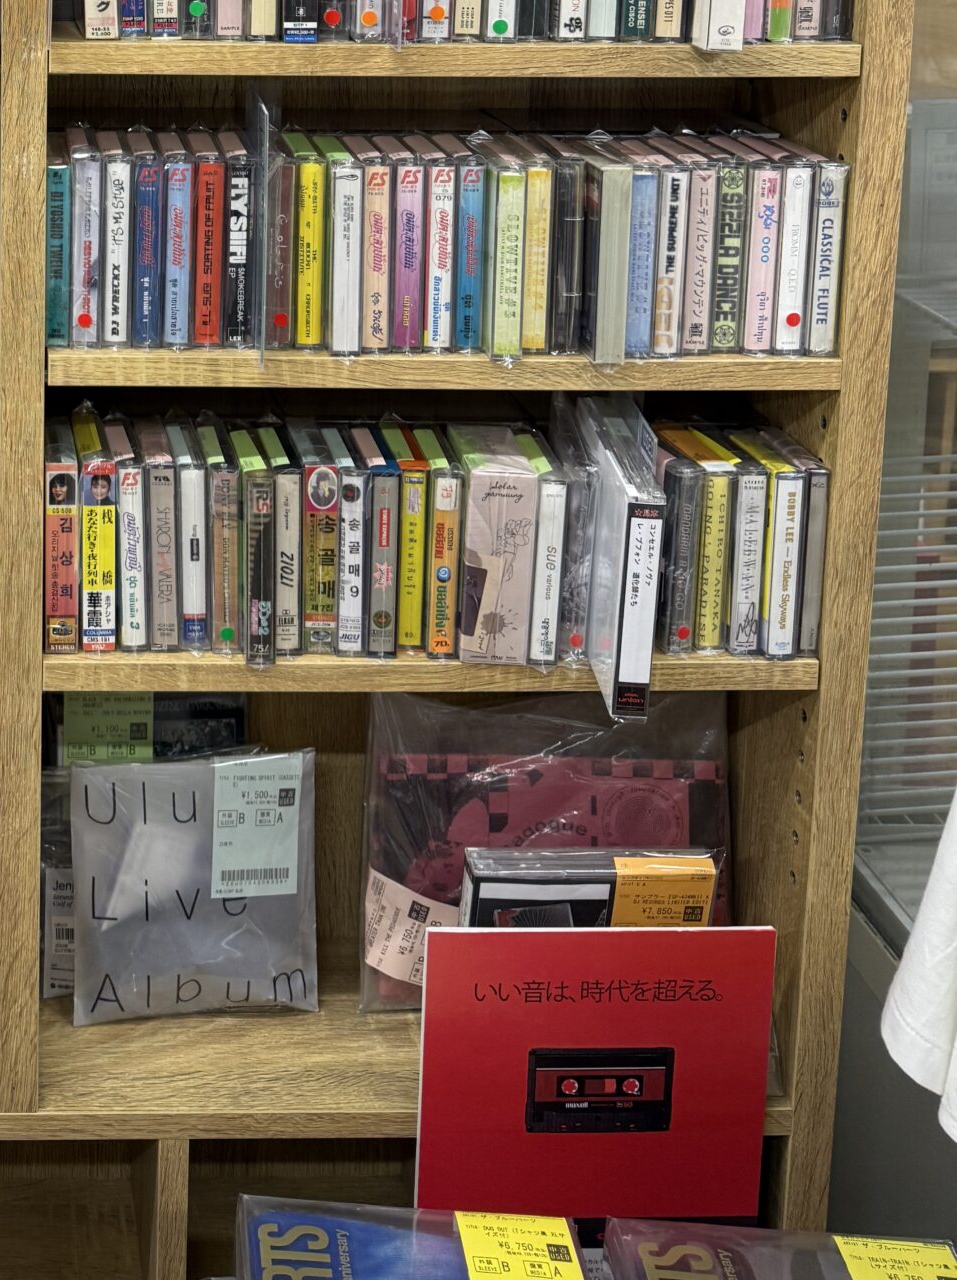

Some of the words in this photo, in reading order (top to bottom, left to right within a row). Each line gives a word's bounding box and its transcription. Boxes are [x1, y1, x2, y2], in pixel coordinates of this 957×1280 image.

[628, 6, 636, 27] CISCO
[664, 11, 674, 23] 011
[670, 177, 680, 202] UNIT
[50, 204, 63, 239] YOSHIO
[666, 205, 679, 252] SUPREME
[665, 254, 675, 274] THE
[818, 218, 834, 280] CLASSICAL
[229, 267, 236, 278] EP
[111, 263, 121, 316] WRECKX
[236, 267, 244, 322] SMOKEBREAK
[816, 288, 830, 325] FLUTE
[111, 320, 120, 336] DJ
[785, 491, 797, 523] BOBBY
[716, 493, 726, 559] ICHIRO
[785, 527, 795, 543] LEE
[59, 517, 74, 599] 김상희
[348, 518, 361, 577] 송골매
[545, 545, 557, 571] sue
[349, 585, 359, 598] 9
[545, 574, 553, 600] various
[781, 560, 792, 592] Endless
[711, 563, 722, 633] TANAKA
[778, 594, 790, 630] Skyways
[90, 968, 307, 1013] Album
[473, 979, 723, 1004] いい音は、時代を超える。
[502, 1262, 510, 1273] B
[553, 1266, 563, 1278] A
